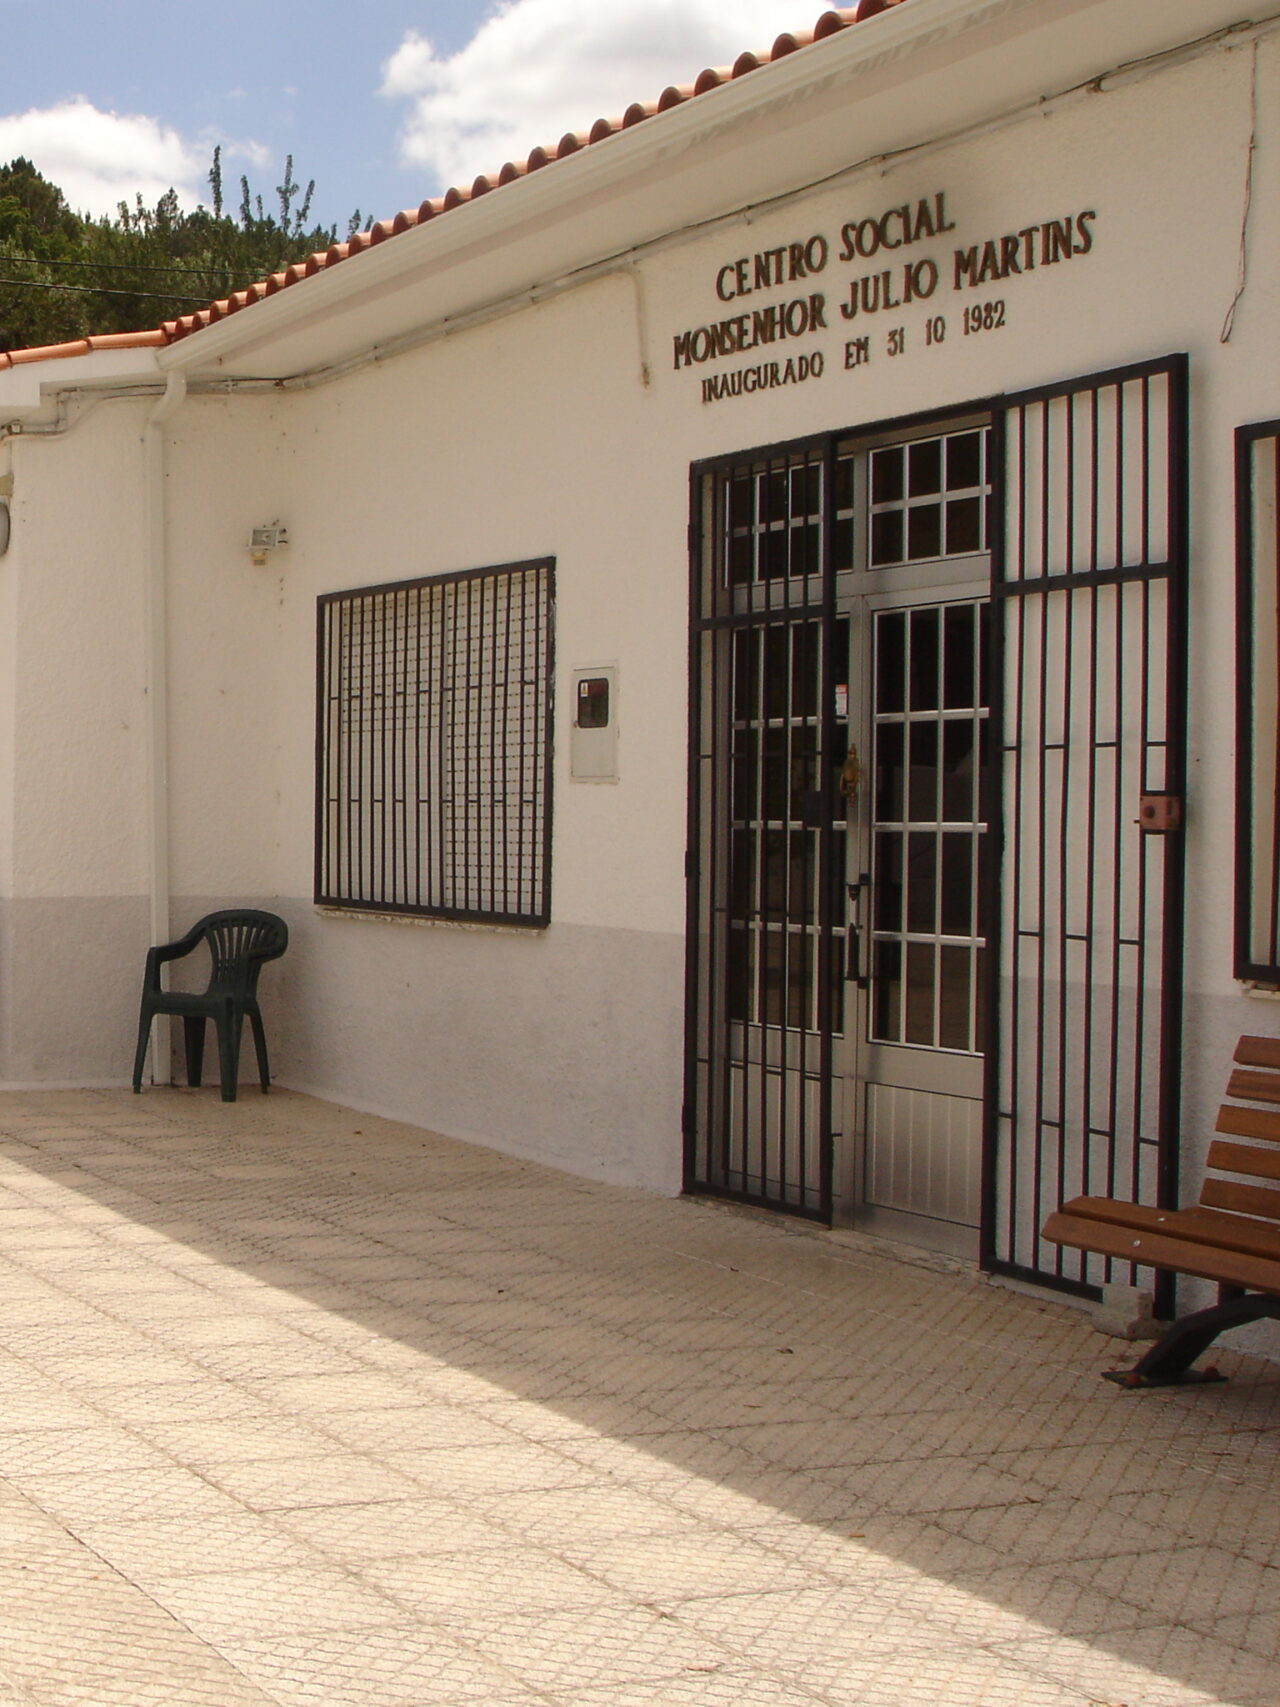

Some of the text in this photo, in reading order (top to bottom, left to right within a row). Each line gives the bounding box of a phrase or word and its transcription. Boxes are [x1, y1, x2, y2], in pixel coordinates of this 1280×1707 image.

[673, 210, 1097, 370] MONSENHOR JULIO MARTINS
[716, 192, 956, 303] CENTRO SOCIAL
[701, 300, 1006, 406] INAUGURADO EM 31 10 1982
